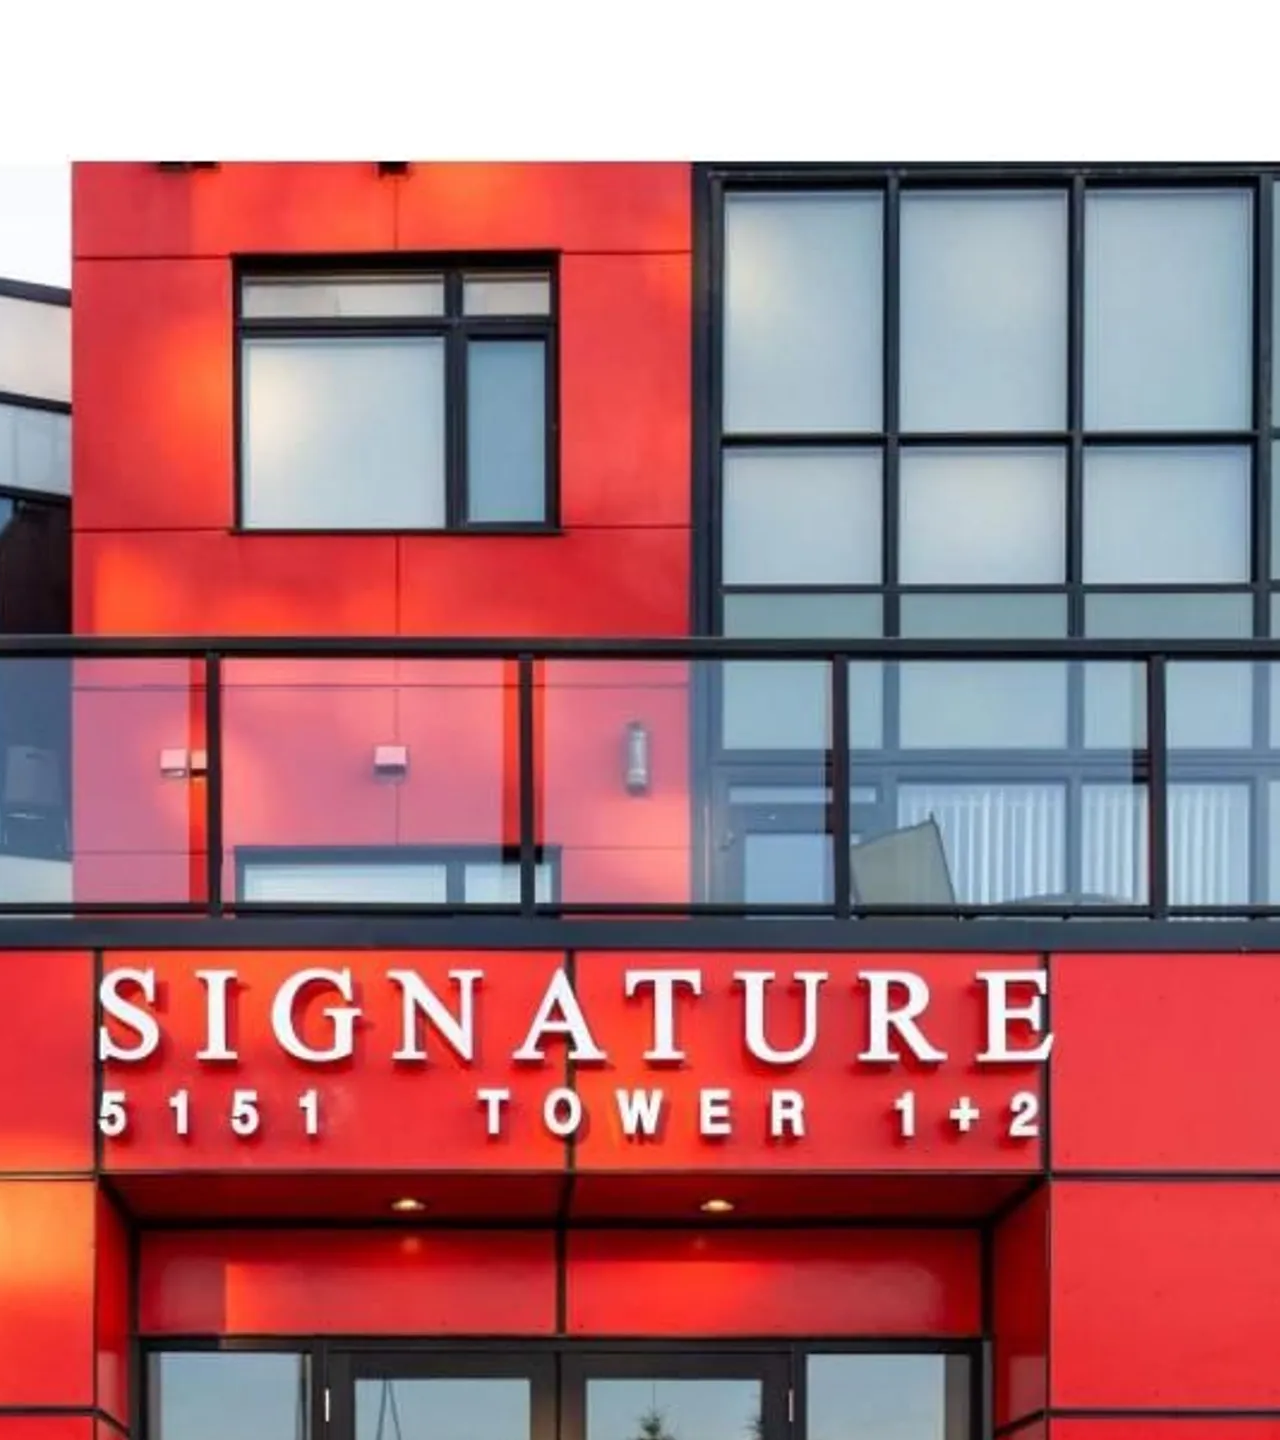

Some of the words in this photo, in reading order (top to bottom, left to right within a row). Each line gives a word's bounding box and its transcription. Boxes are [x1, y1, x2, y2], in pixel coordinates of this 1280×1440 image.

[99, 968, 1055, 1063] SIGNATURE
[99, 1089, 317, 1135] 5151
[477, 1088, 805, 1136] TOWER
[896, 1091, 1039, 1136] 1+2
